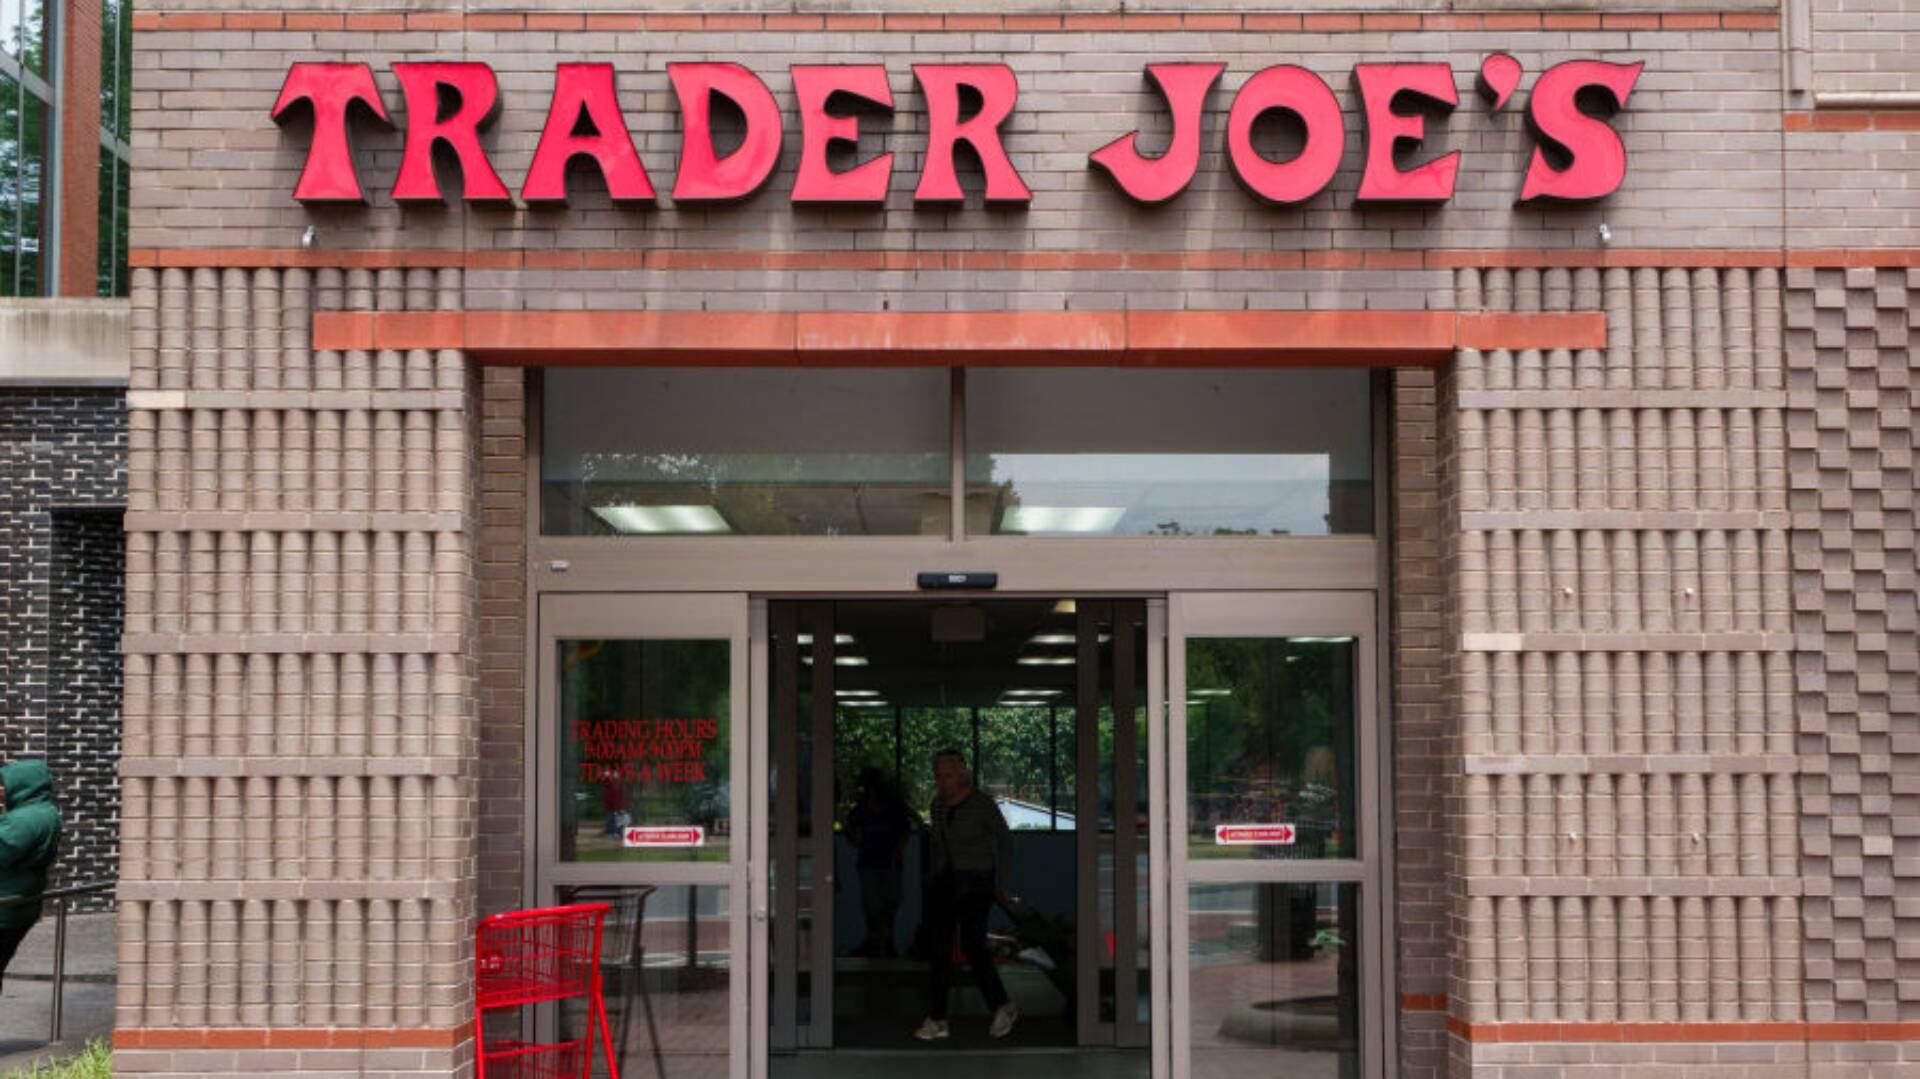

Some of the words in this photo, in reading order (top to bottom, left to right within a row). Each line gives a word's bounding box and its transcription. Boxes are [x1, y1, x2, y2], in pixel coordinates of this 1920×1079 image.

[271, 62, 1032, 202] TRADER
[1088, 53, 1644, 204] JOE'S
[570, 719, 651, 740] TRADING
[655, 719, 718, 740] HOURS
[656, 761, 707, 782] WEEK
